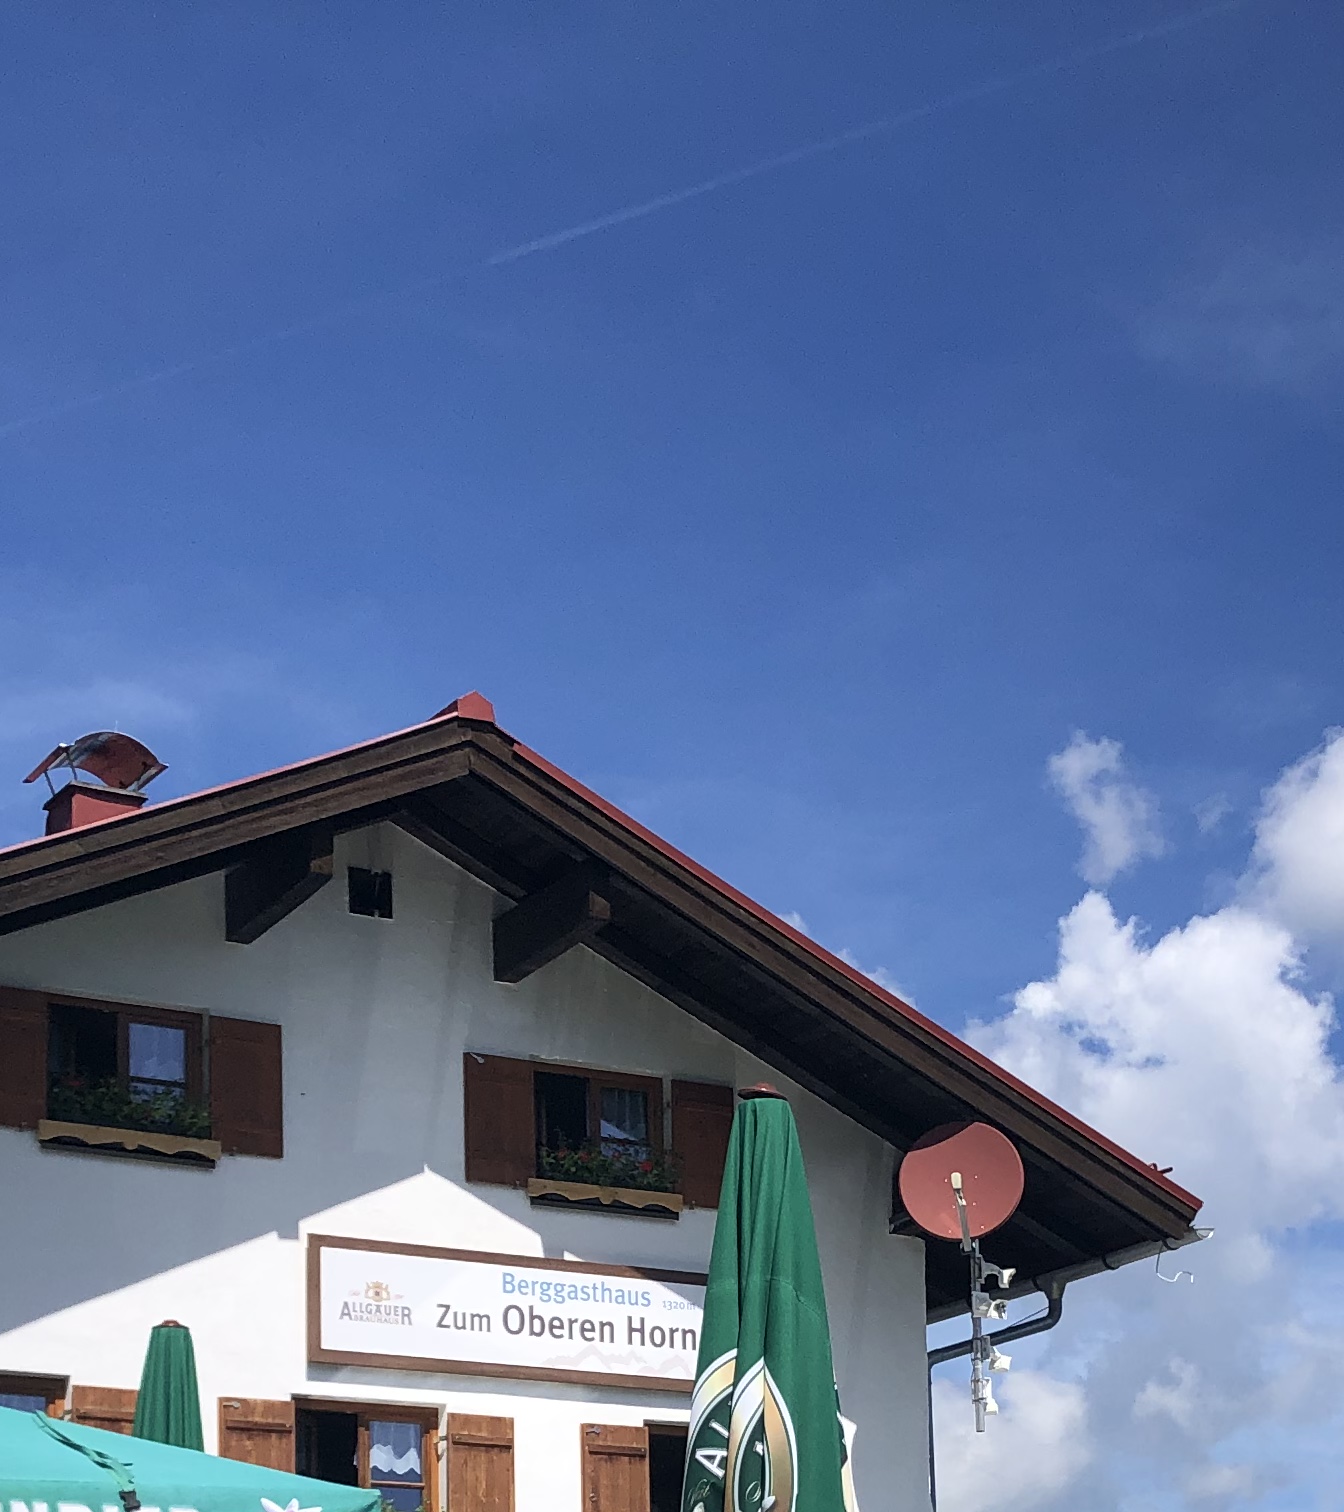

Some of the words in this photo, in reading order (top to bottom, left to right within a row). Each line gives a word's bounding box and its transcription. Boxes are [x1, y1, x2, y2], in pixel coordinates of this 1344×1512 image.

[501, 1272, 652, 1308] Berggasthaus
[338, 1300, 413, 1326] ALLGÄUER
[435, 1303, 492, 1333] Zum
[502, 1304, 615, 1343] Oberen
[626, 1315, 697, 1351] Horn
